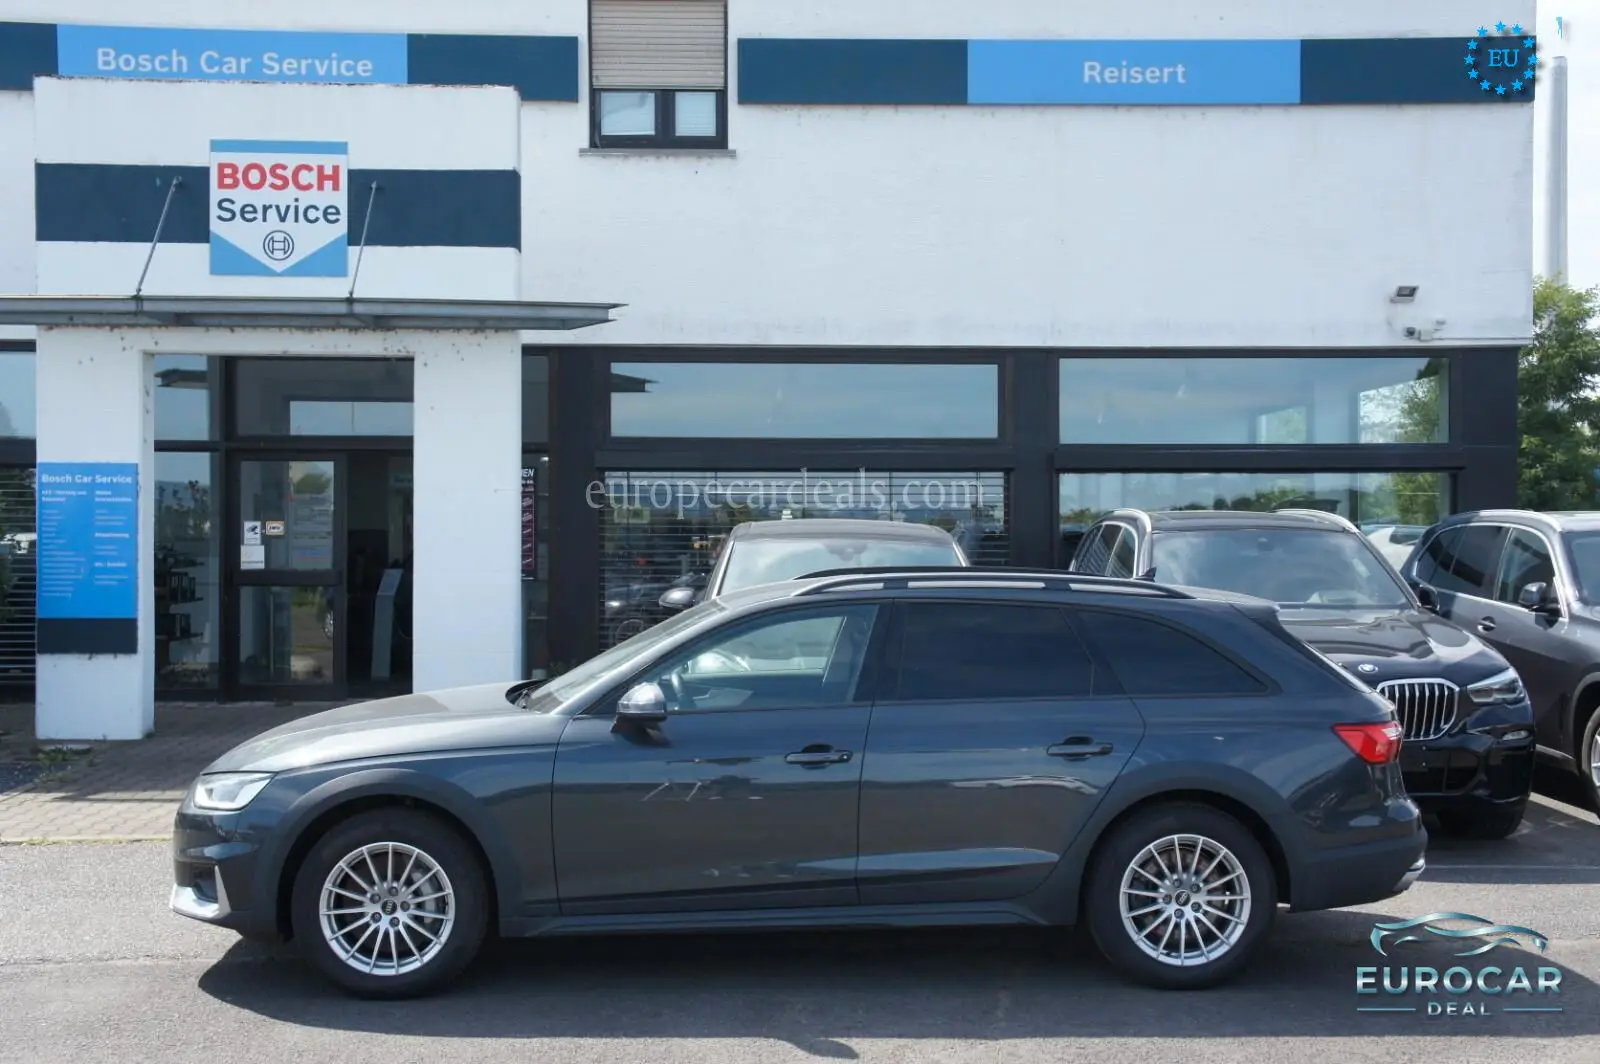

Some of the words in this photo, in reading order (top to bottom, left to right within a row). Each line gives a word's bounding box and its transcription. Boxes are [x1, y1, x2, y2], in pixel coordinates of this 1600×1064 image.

[97, 48, 187, 73] Bosch
[200, 50, 252, 74] Car
[262, 52, 373, 77] Service
[1083, 60, 1187, 84] Reisert
[217, 162, 340, 191] BOSCH
[216, 197, 341, 224] Service
[42, 473, 72, 484] Bosch
[75, 473, 93, 484] Car
[95, 474, 133, 484] Service
